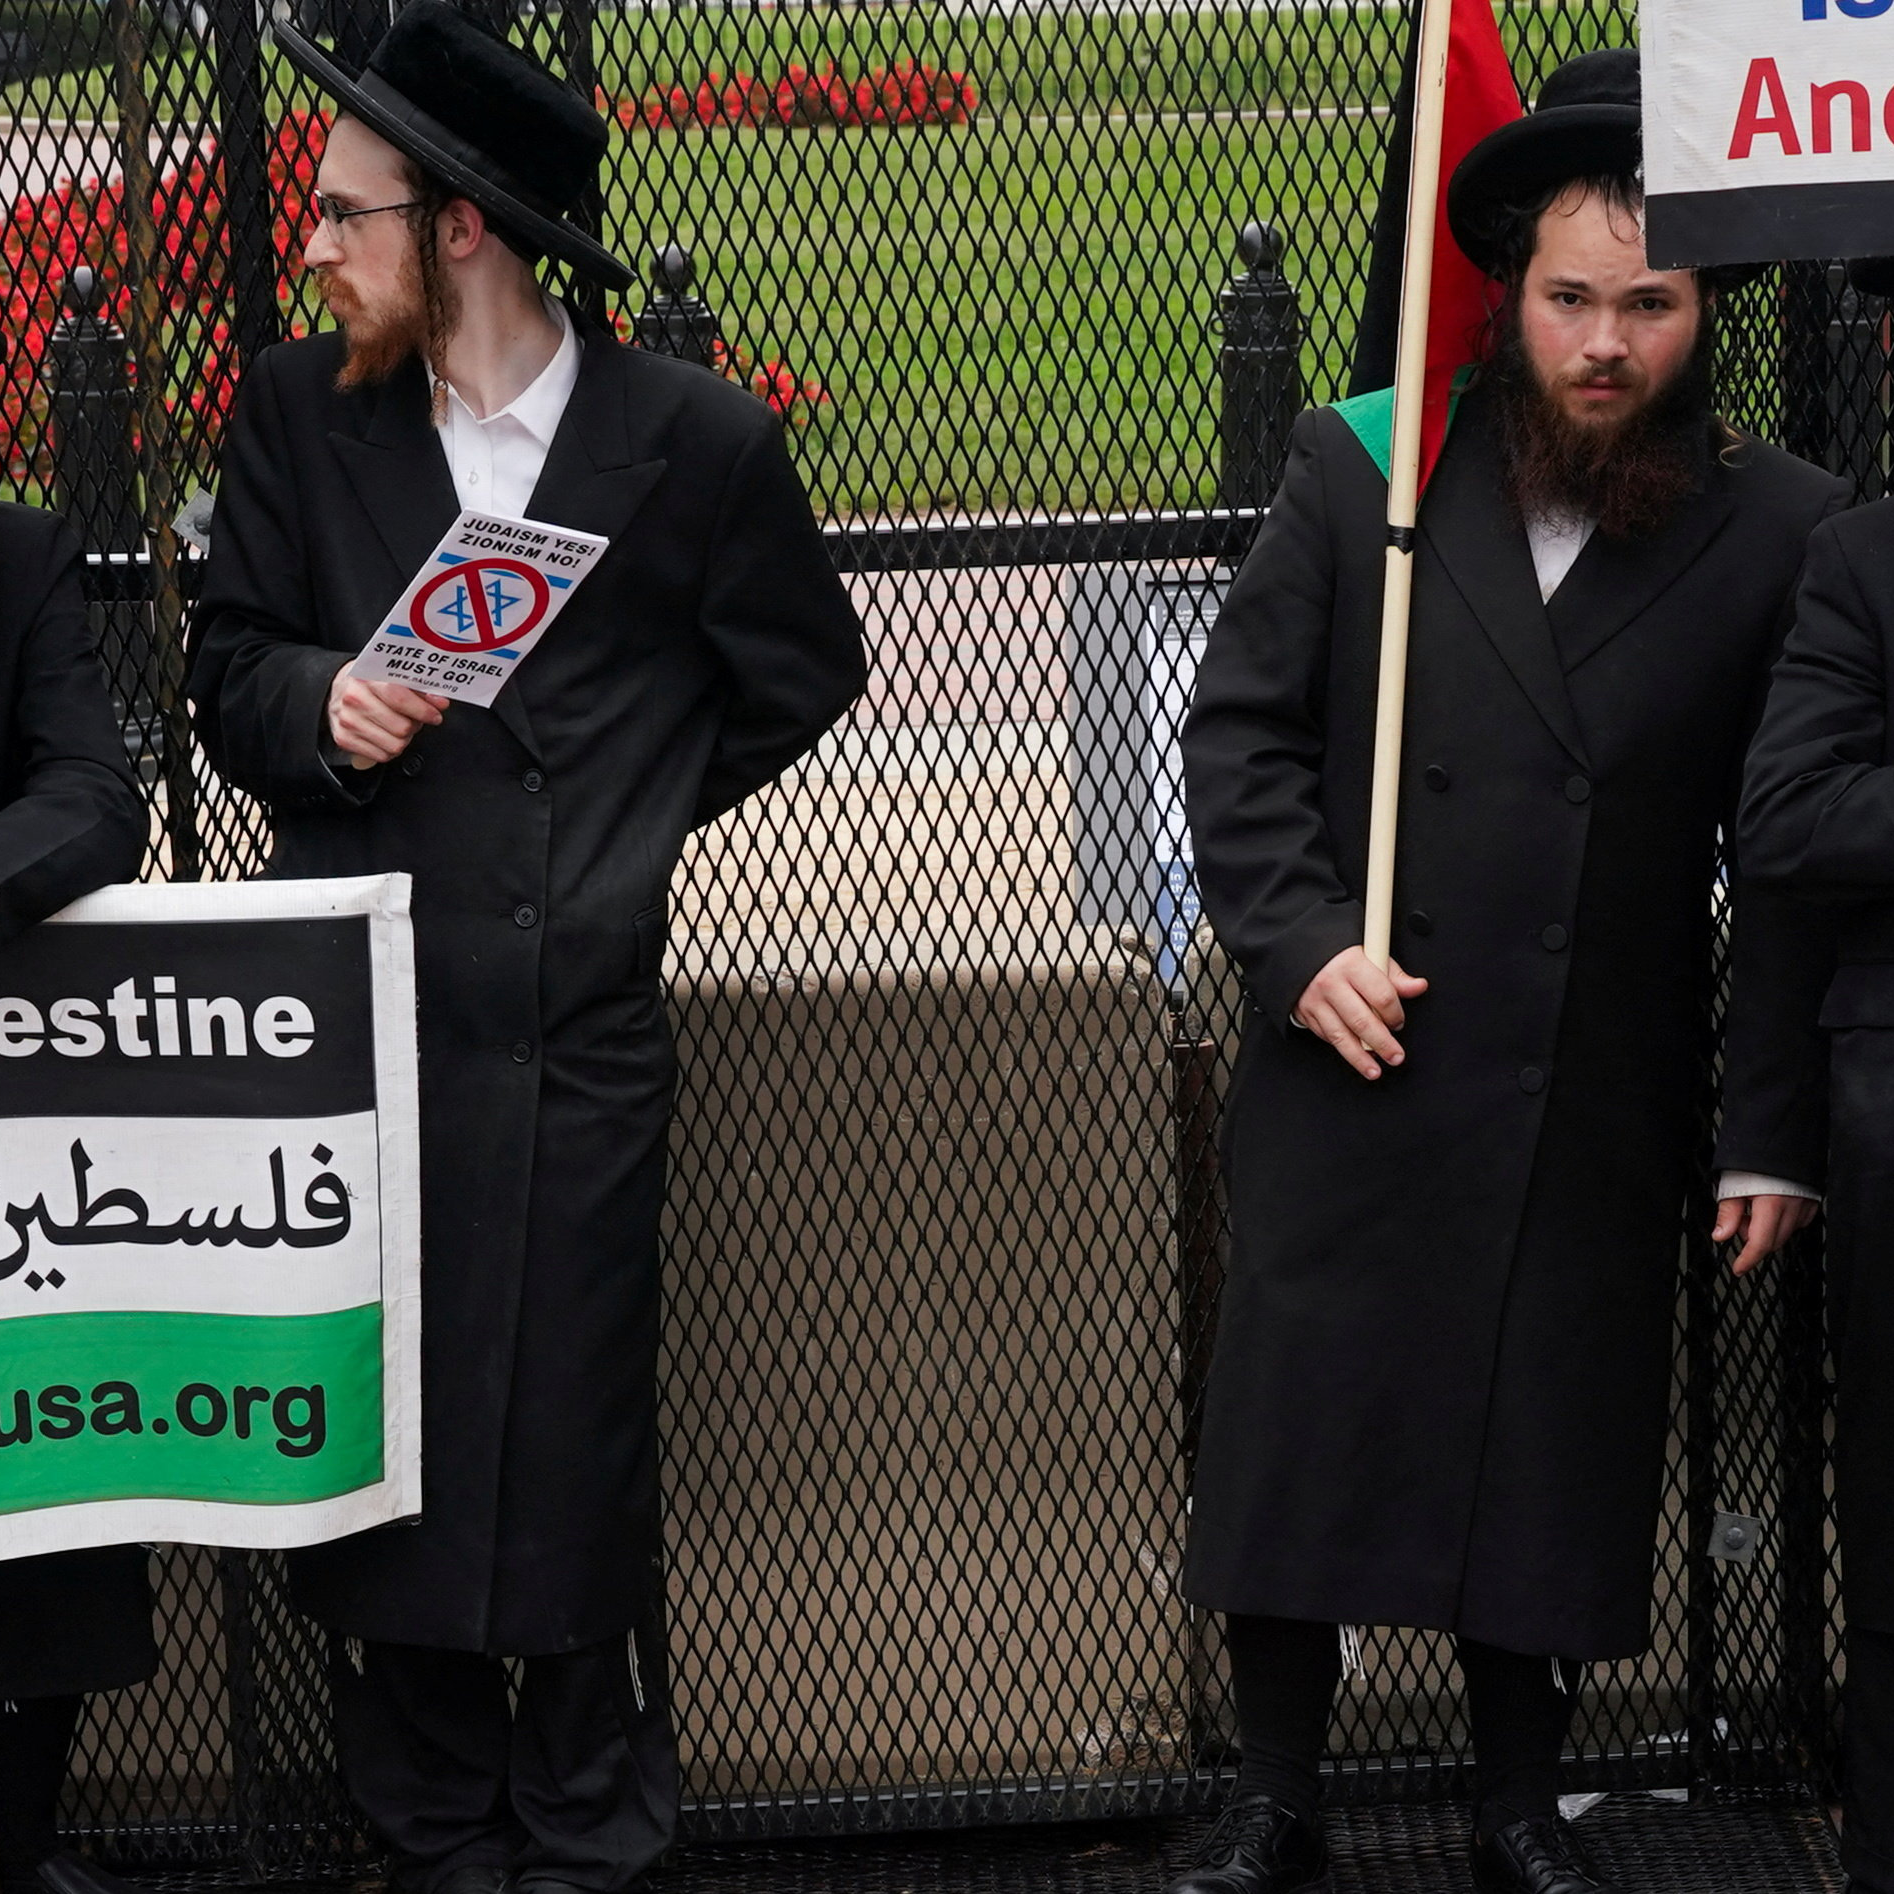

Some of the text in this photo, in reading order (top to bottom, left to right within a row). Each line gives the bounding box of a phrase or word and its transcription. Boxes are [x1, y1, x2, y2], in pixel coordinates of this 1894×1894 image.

[459, 533, 581, 569] ZIONISM NO!
[463, 518, 597, 556] JUDAISM YES!
[374, 642, 504, 678] STATE OF ISRAEL
[386, 659, 475, 686] MUST GO!
